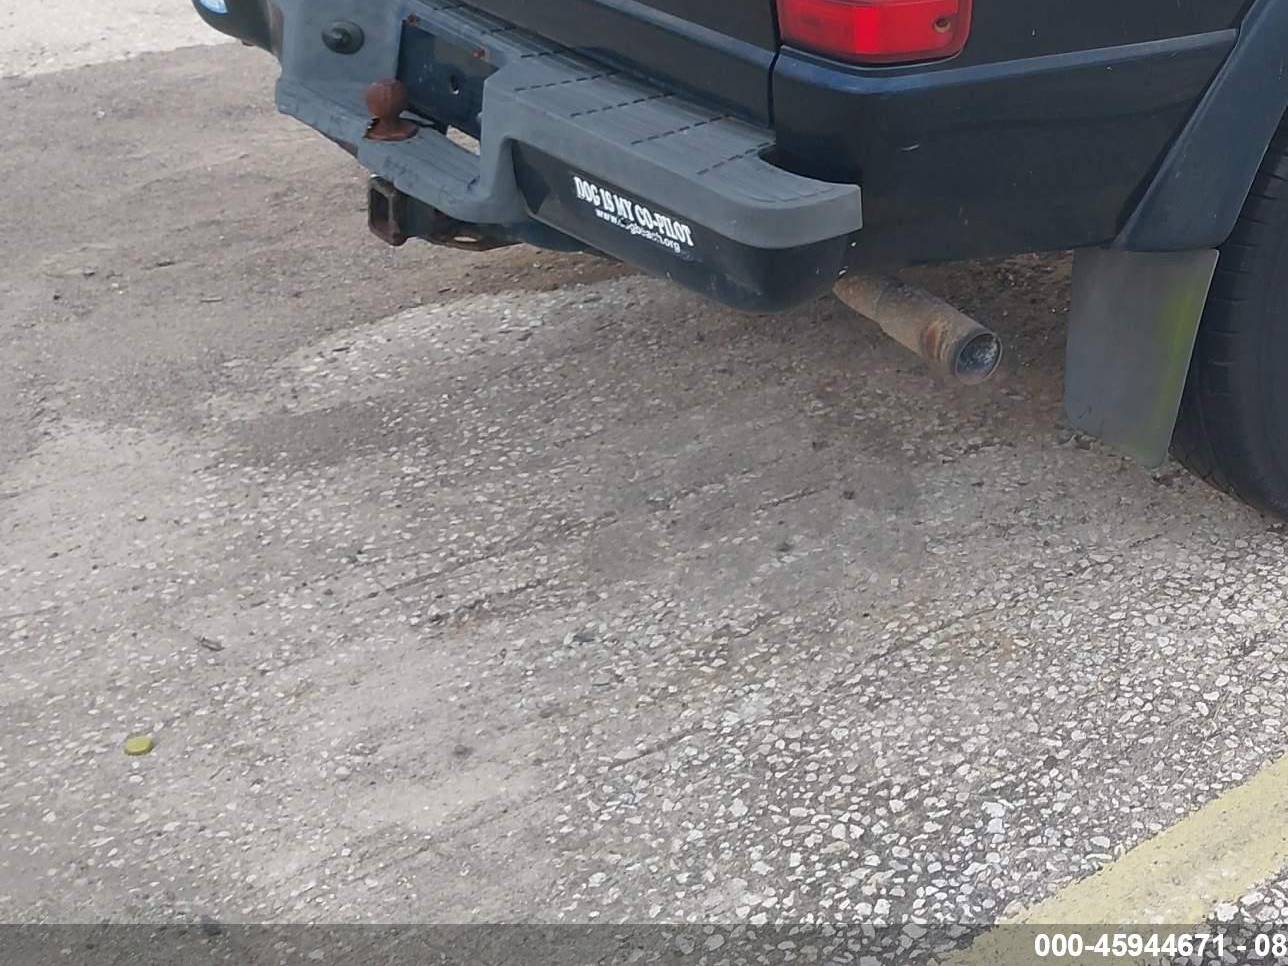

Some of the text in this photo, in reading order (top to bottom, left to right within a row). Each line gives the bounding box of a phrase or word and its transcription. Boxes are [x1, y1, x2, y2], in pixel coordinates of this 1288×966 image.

[574, 176, 694, 246] DOG IS MY CO-PILOT
